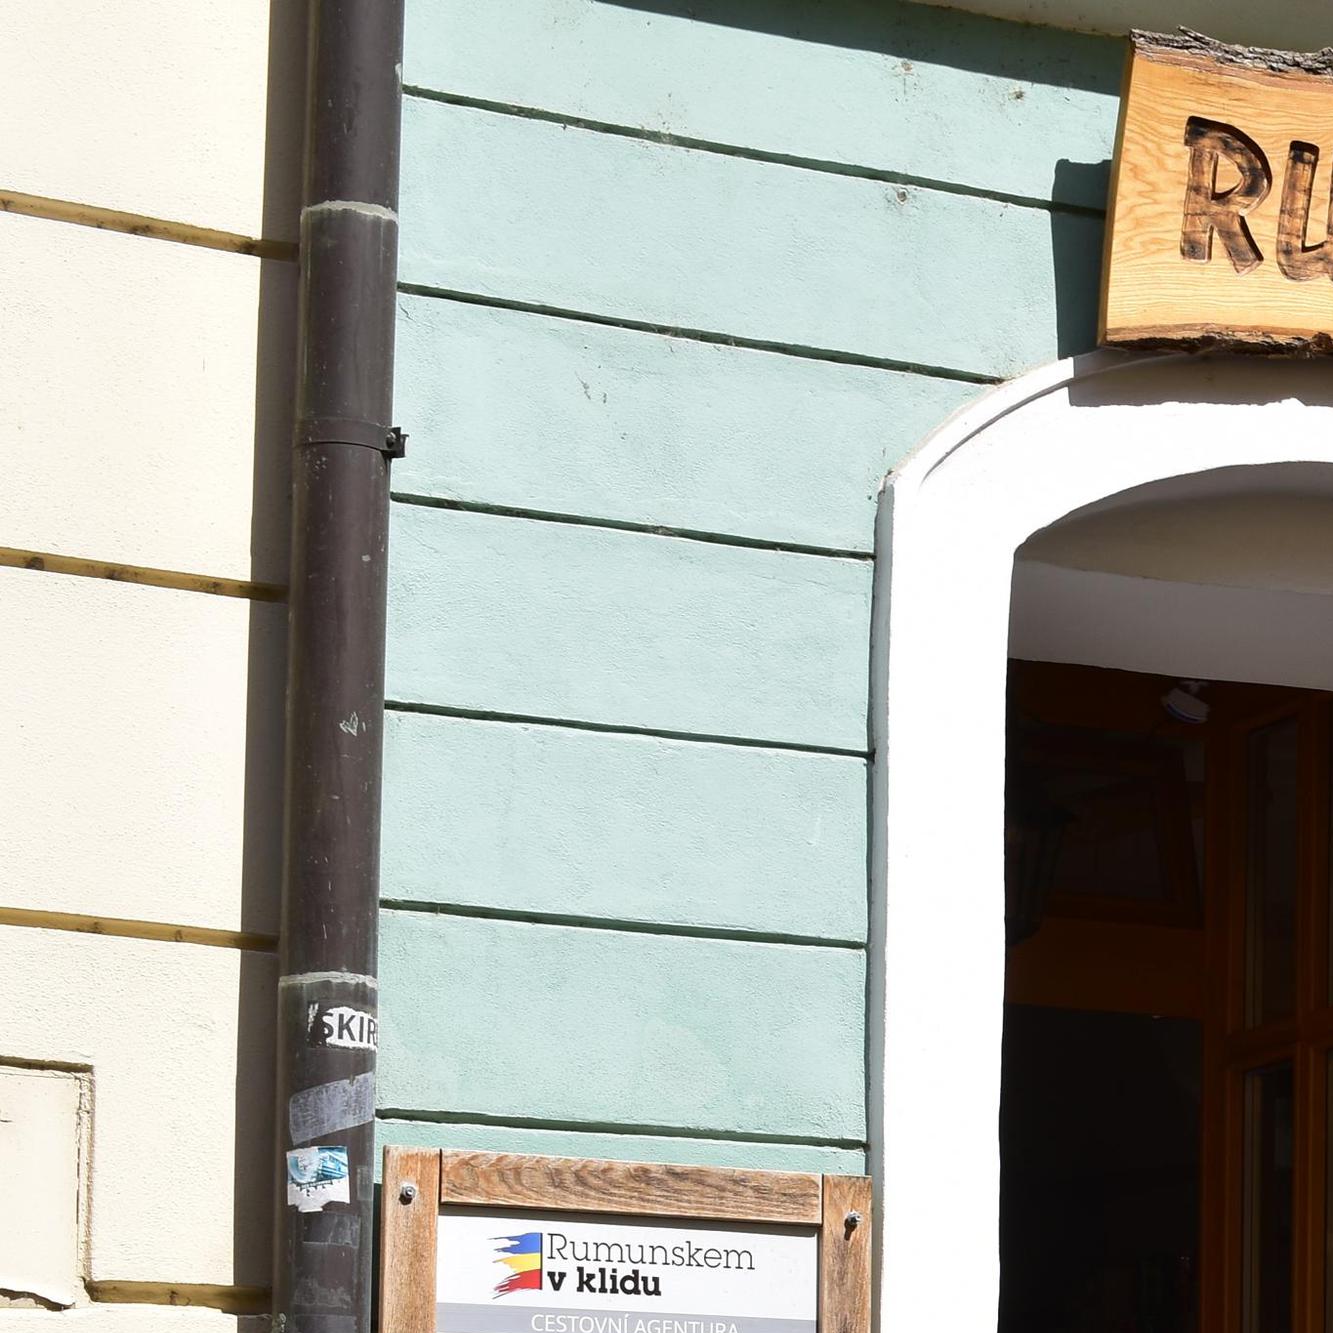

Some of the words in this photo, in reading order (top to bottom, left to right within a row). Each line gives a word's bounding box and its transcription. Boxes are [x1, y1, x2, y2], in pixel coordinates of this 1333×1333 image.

[547, 1233, 756, 1270] Rumunskem
[548, 1272, 566, 1291] v
[576, 1267, 662, 1296] klidu
